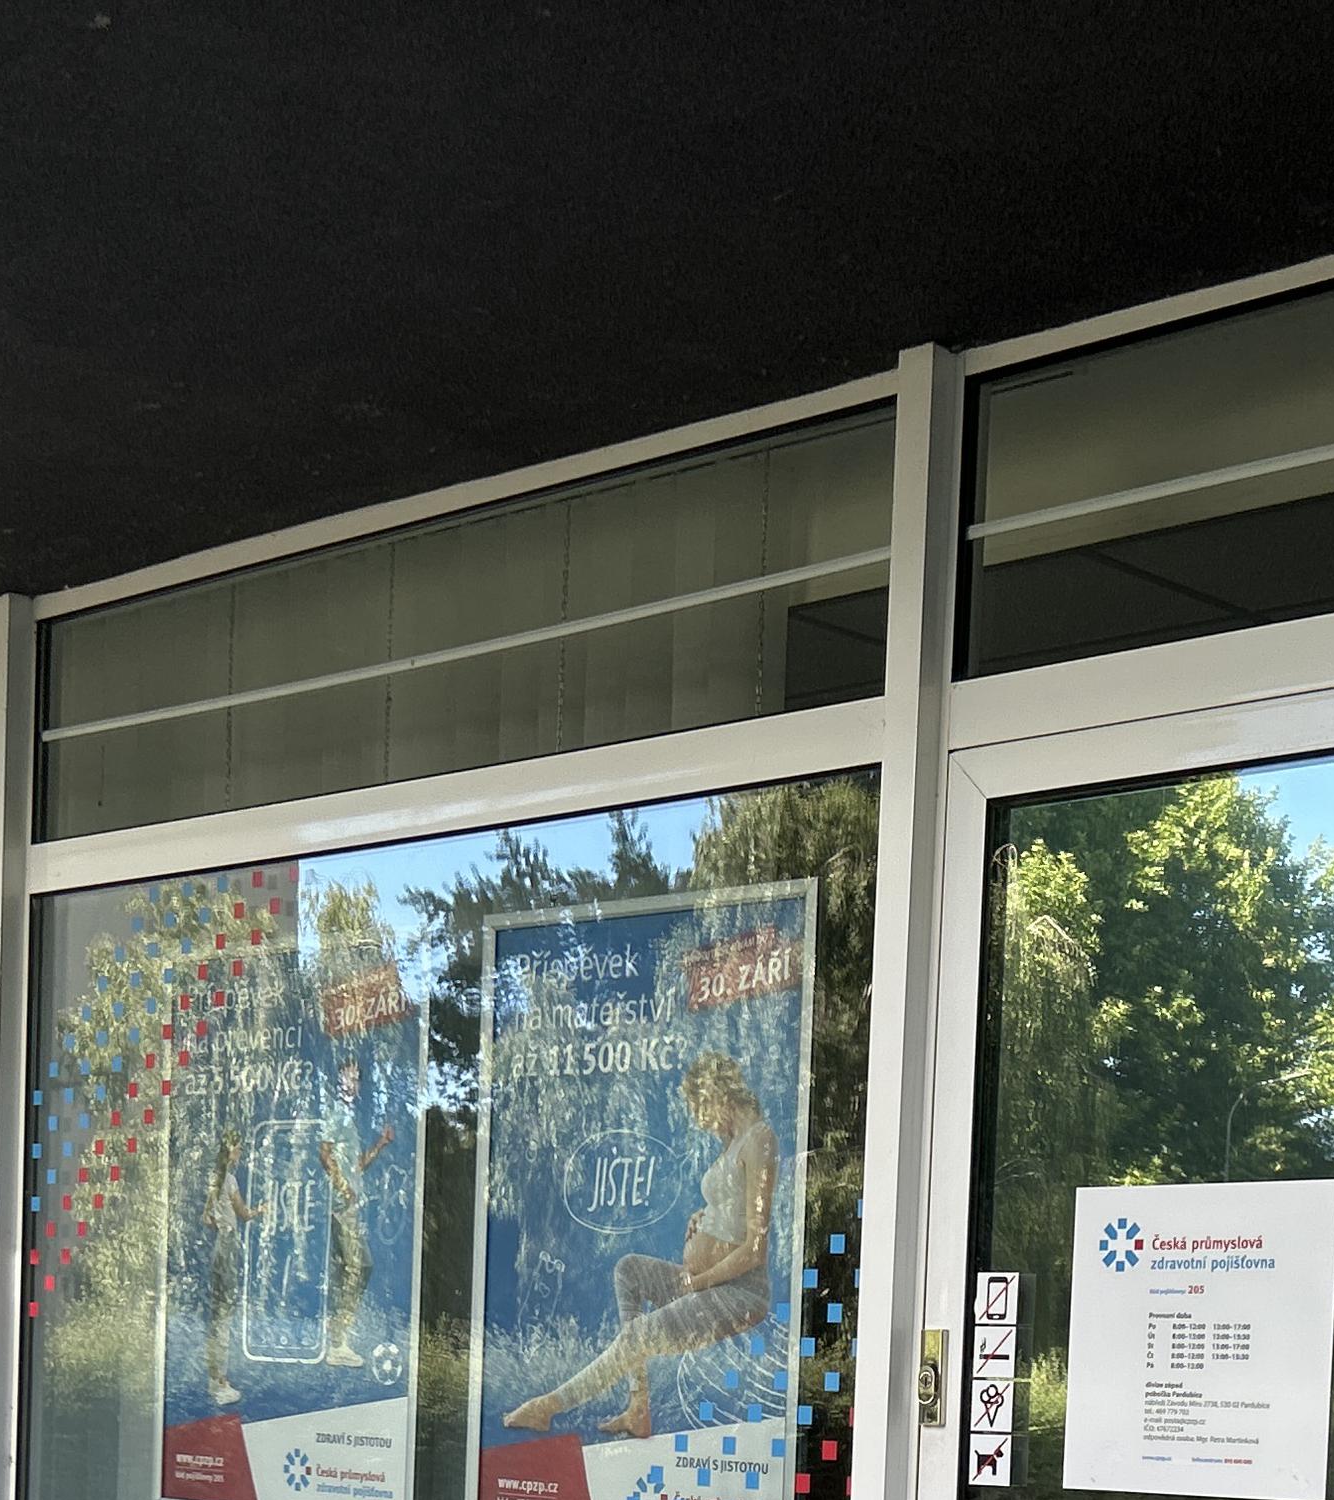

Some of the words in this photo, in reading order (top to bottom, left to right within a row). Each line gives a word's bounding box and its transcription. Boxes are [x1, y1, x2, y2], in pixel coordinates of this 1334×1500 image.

[738, 946, 792, 991] ZÁŘÍ
[553, 988, 676, 1031] mateřství
[581, 1042, 630, 1076] 500
[1152, 1234, 1187, 1251] Česká
[1191, 1235, 1263, 1253] průmyslová
[1150, 1256, 1207, 1270] zdravotní
[1210, 1255, 1276, 1272] pojišťovna
[1187, 1285, 1205, 1294] 205
[315, 1432, 345, 1444] ZDRAVÍ
[347, 1435, 352, 1445] S
[353, 1436, 392, 1448] JISTOTOU
[675, 1456, 710, 1470] ZDRAVÍ
[712, 1459, 718, 1471] S
[720, 1461, 769, 1475] JISTOTOU
[497, 1478, 559, 1494] www.cpzp.cz
